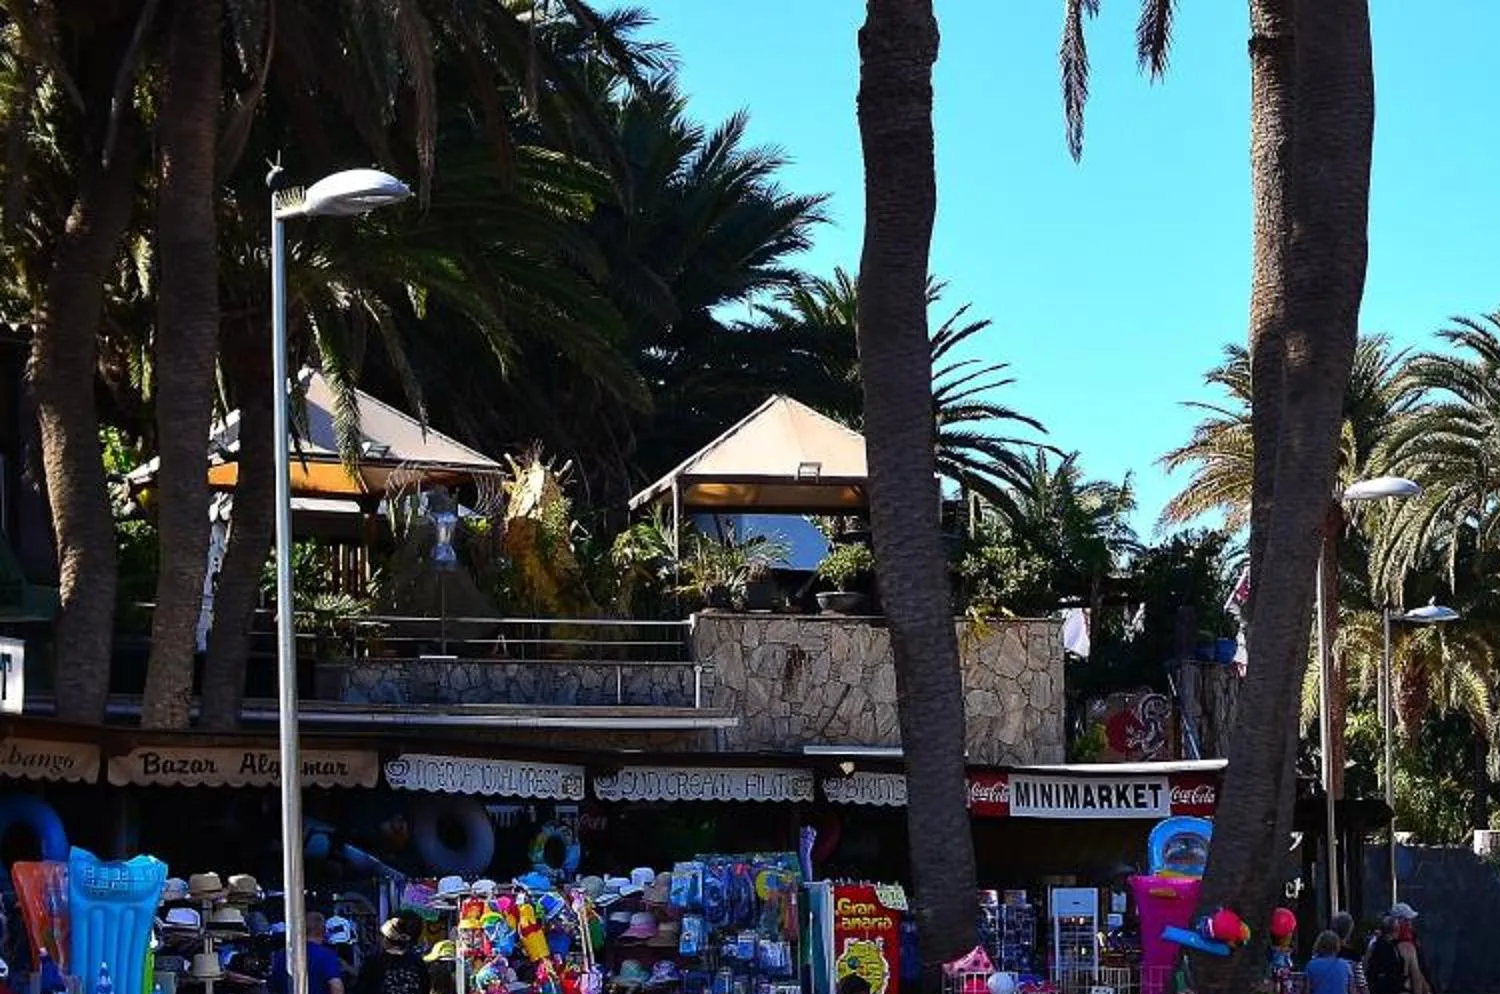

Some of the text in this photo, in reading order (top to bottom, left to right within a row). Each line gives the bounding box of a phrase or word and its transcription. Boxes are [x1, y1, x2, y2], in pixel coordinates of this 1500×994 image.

[138, 753, 218, 776] Bazar
[665, 772, 732, 797] CREAM
[1014, 782, 1163, 809] MINIMARKET
[838, 898, 876, 915] Gran
